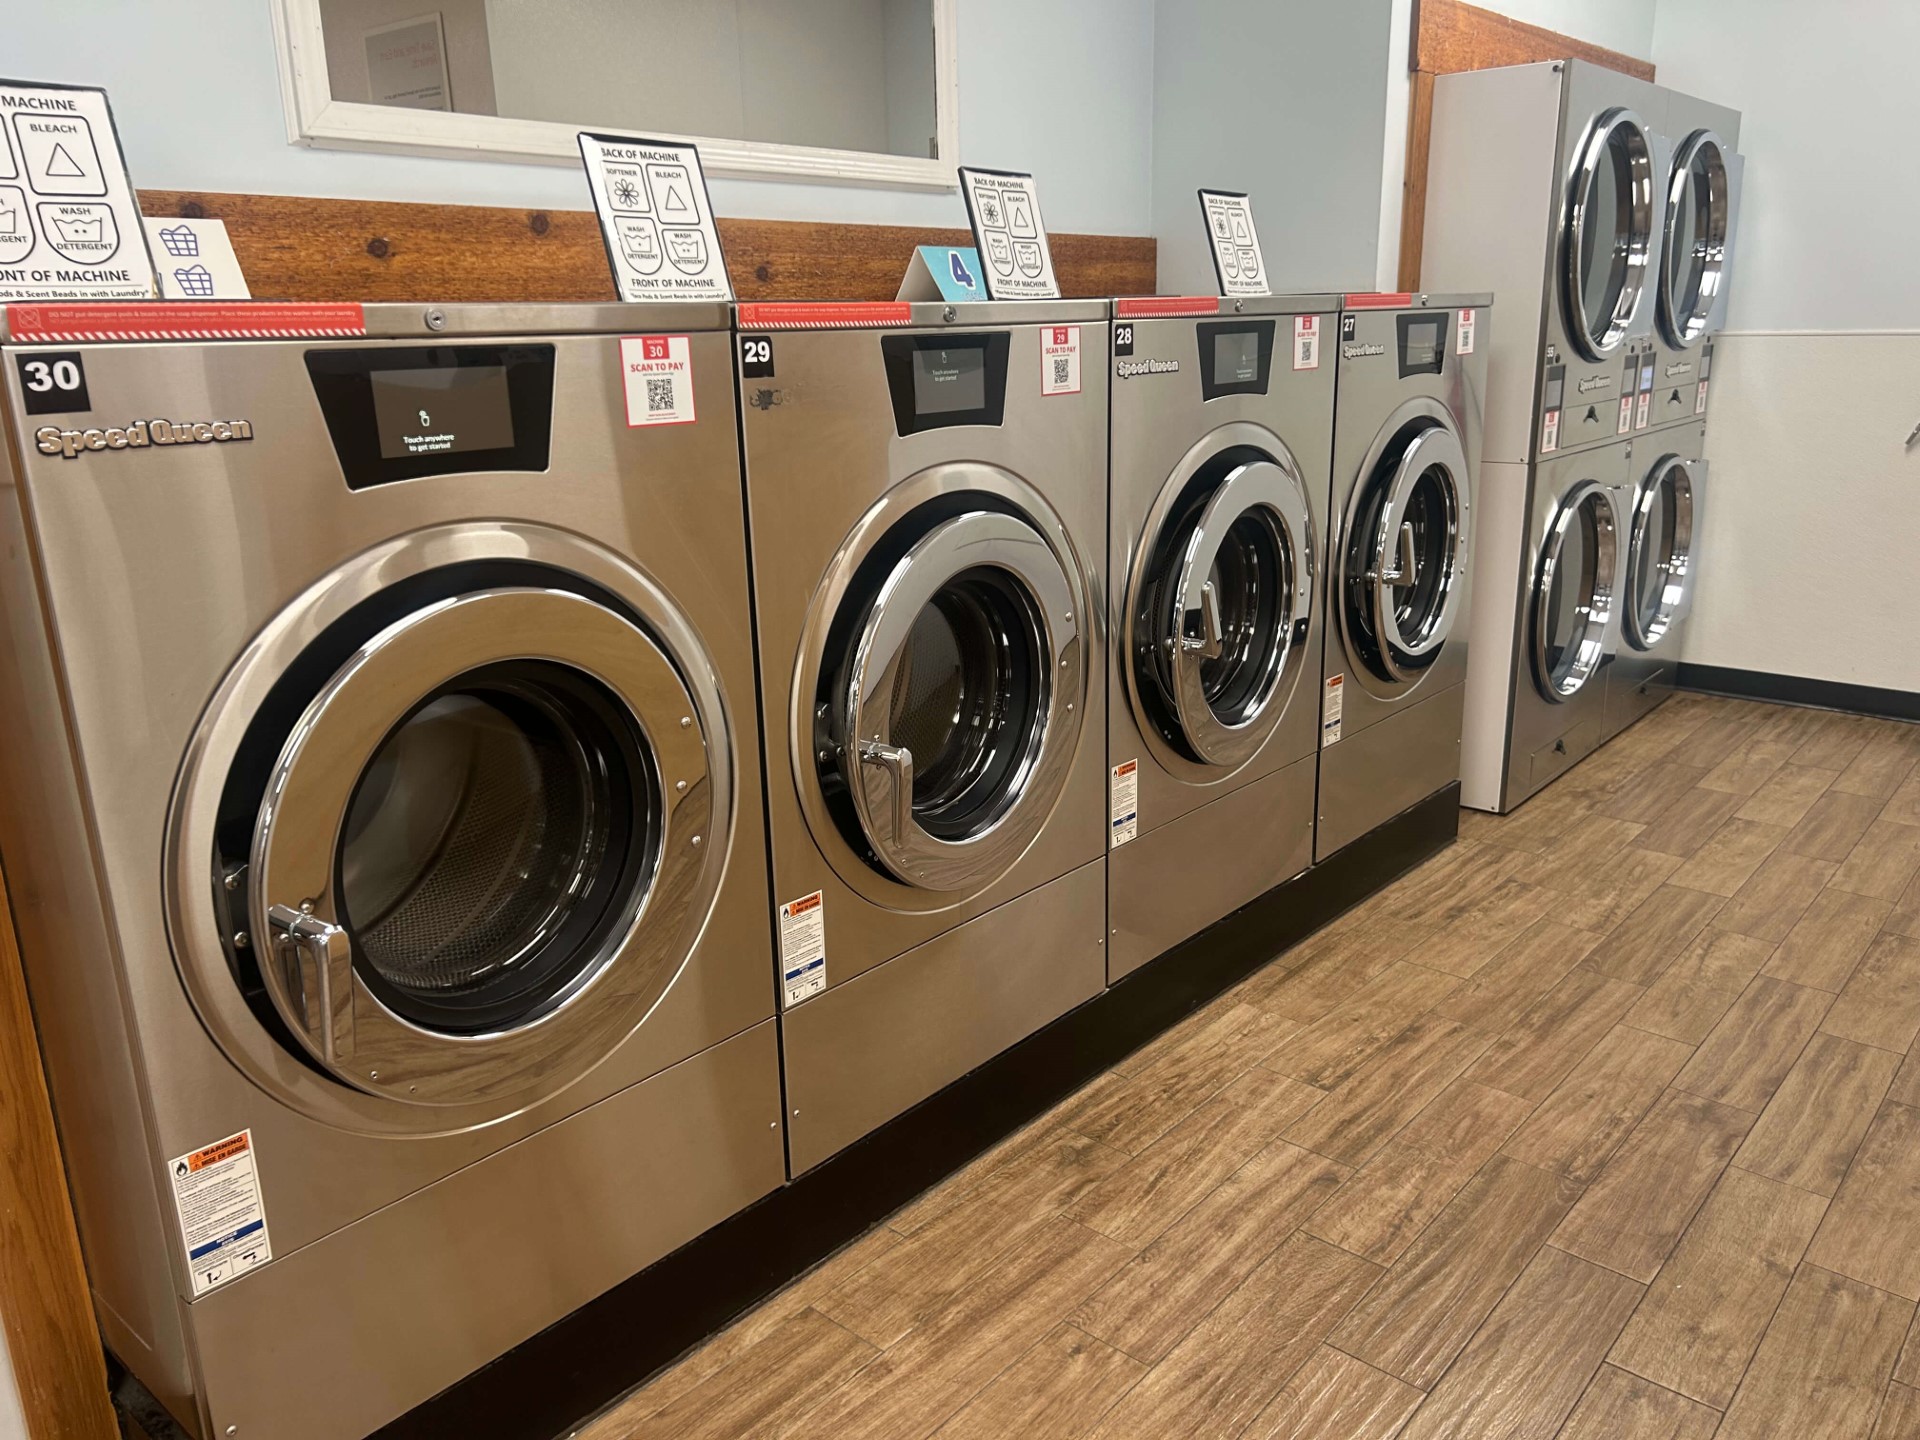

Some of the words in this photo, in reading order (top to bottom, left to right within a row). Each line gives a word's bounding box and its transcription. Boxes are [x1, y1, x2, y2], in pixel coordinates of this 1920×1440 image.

[1, 95, 77, 111] MACHINE
[30, 123, 78, 134] BLEACH
[625, 149, 637, 159] OF
[640, 151, 681, 162] MACHINE
[606, 168, 637, 176] SOFTENER
[997, 180, 1024, 189] MACHINE
[59, 207, 91, 215] WASH
[31, 270, 51, 281] OF
[56, 270, 130, 281] MACHINE
[949, 250, 976, 290] 4
[631, 278, 659, 287] FRONT
[662, 279, 673, 287] OF
[675, 279, 715, 288] MACHINE
[1344, 318, 1355, 331] 27
[1116, 327, 1132, 345] 28
[649, 346, 663, 357] 30
[744, 341, 770, 363] 29
[631, 363, 653, 372] SCAN
[655, 362, 666, 371] TO
[668, 362, 684, 371] PAY
[1117, 359, 1150, 379] Speed
[1149, 358, 1179, 373] Queen
[24, 361, 80, 391] 30
[36, 420, 151, 459] Speed
[150, 418, 253, 448] Queen
[424, 434, 455, 442] anywhere
[417, 444, 428, 452] get
[429, 442, 451, 450] started
[202, 1136, 243, 1156] WARNING
